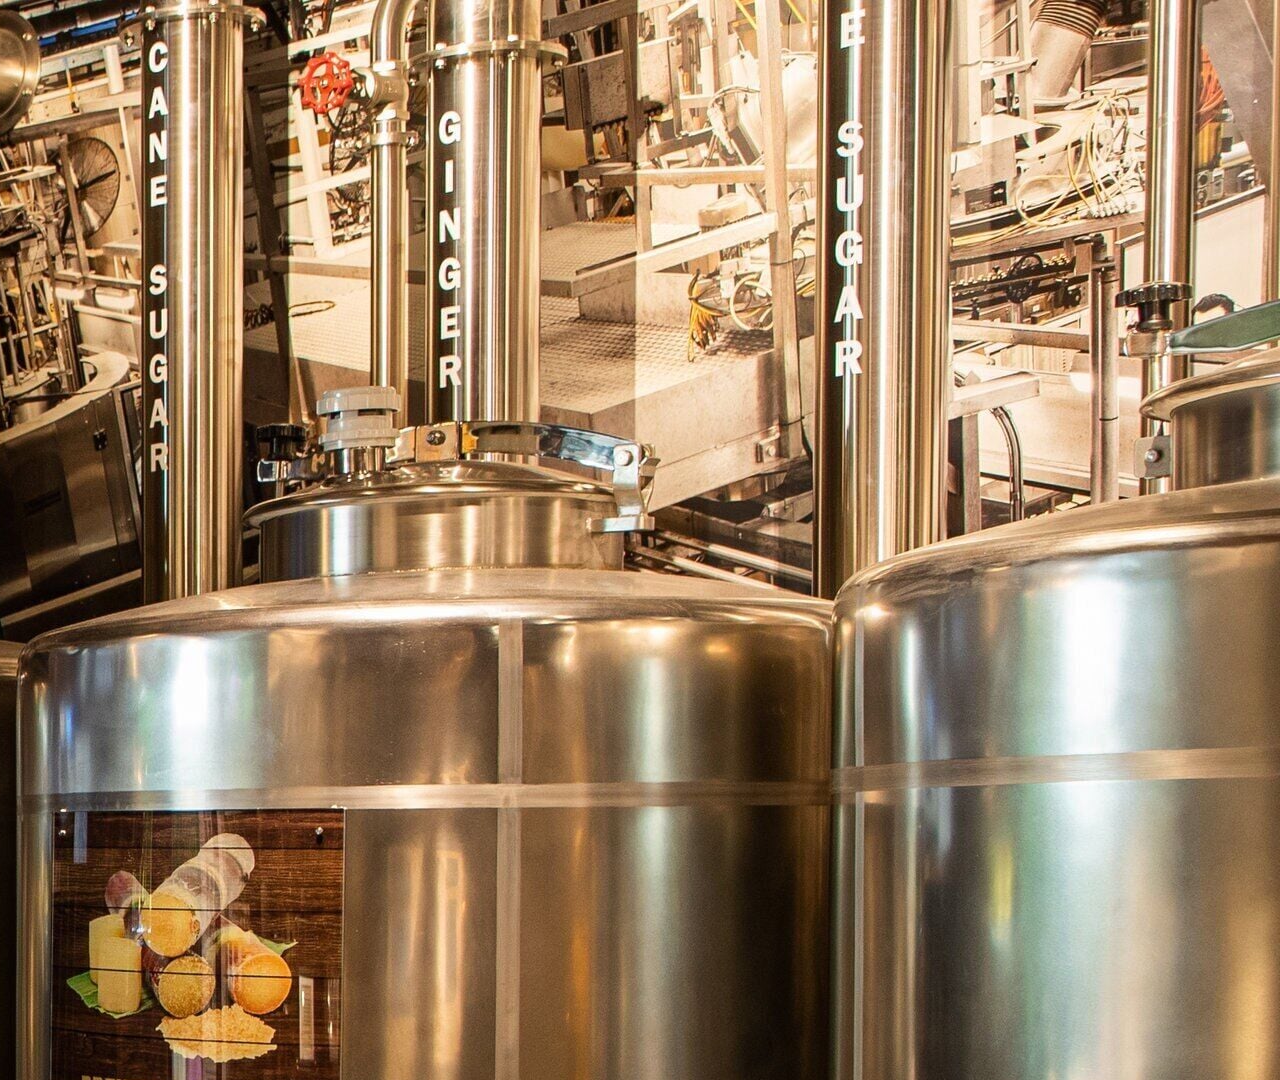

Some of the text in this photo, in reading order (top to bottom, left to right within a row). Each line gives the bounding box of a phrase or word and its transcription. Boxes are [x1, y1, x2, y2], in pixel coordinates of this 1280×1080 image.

[148, 41, 169, 472] CANE SUGAR
[438, 110, 462, 389] GINGER
[834, 120, 865, 377] SUGAR
